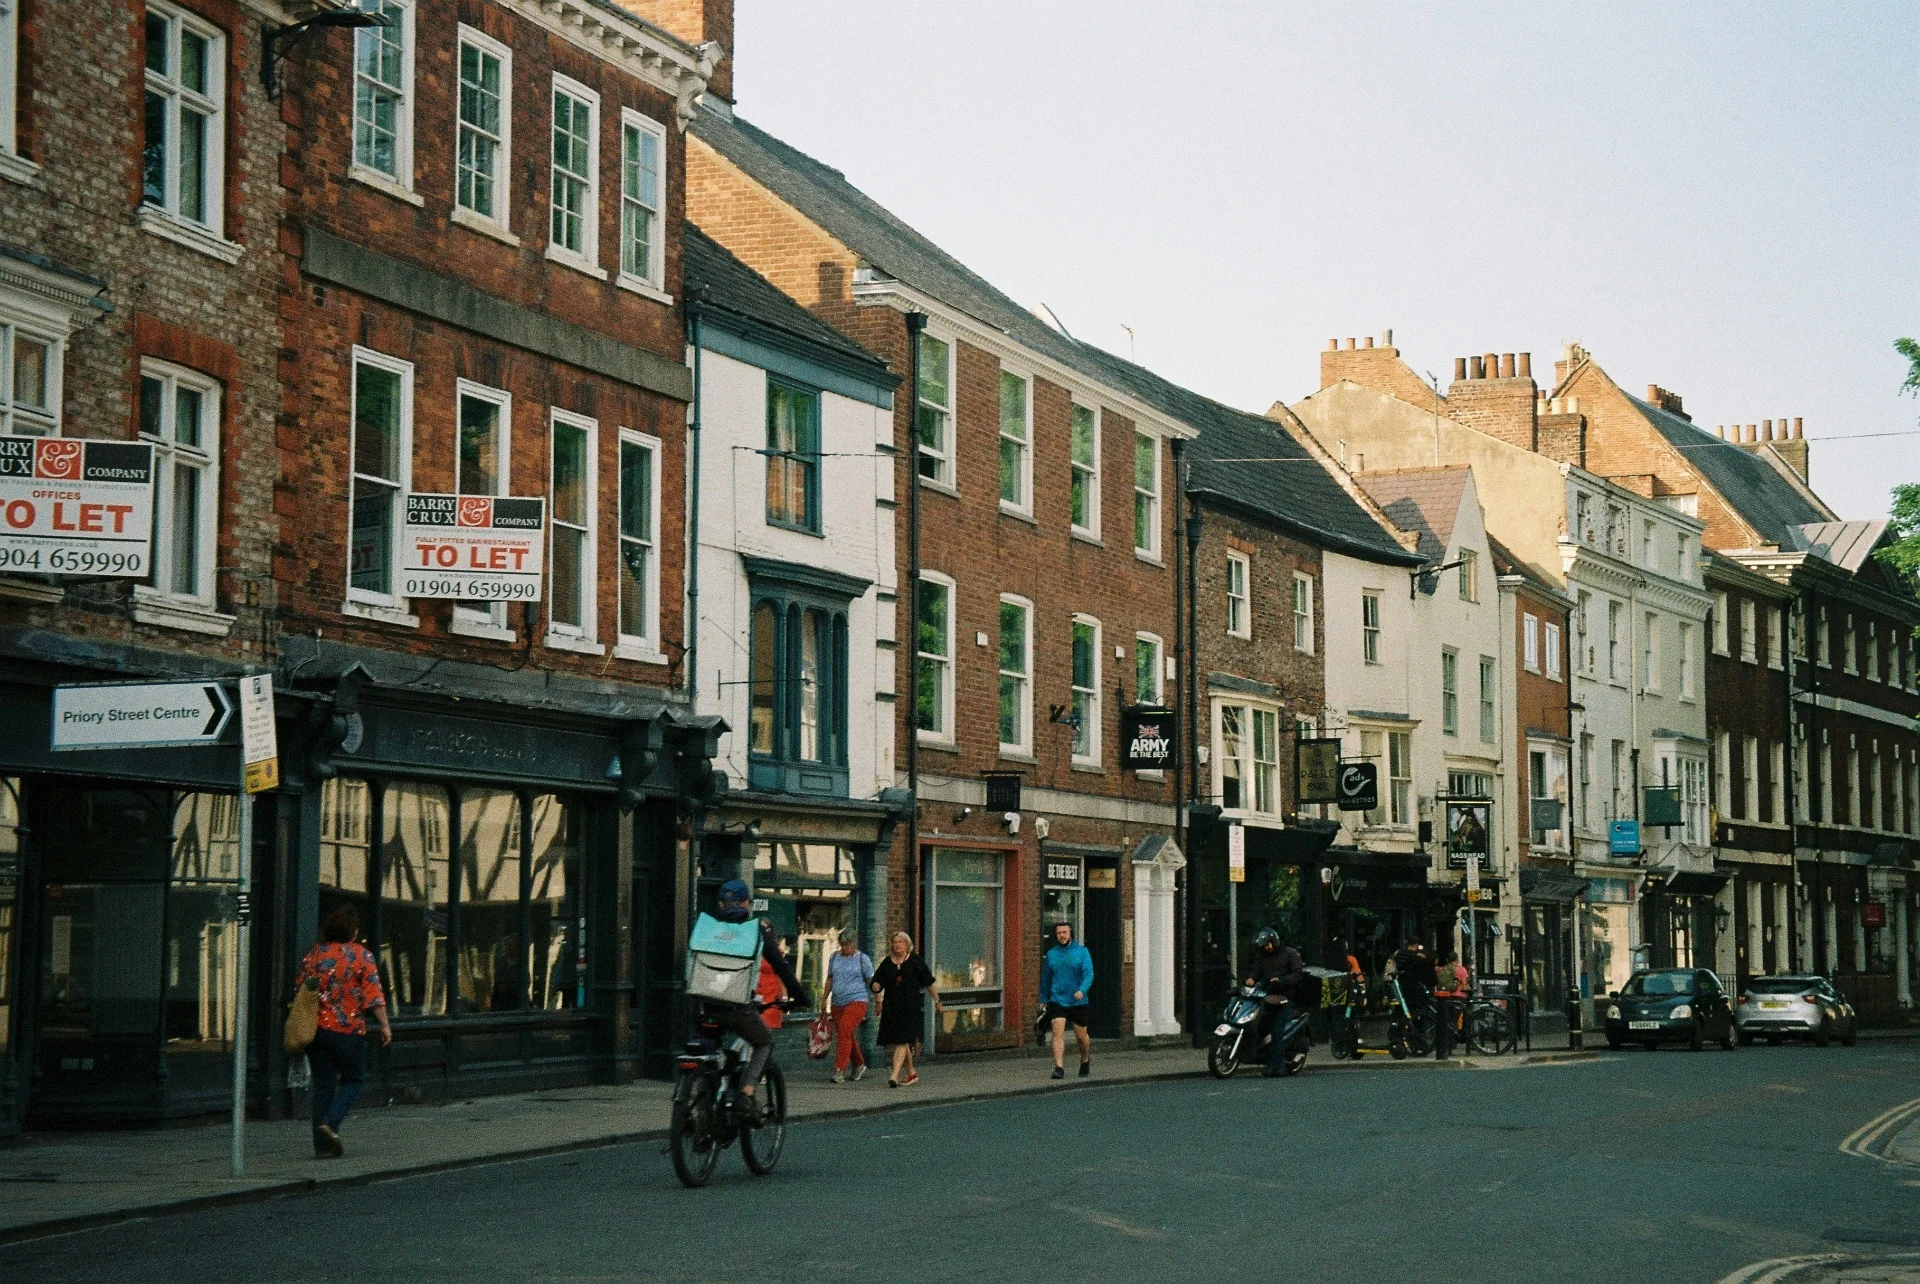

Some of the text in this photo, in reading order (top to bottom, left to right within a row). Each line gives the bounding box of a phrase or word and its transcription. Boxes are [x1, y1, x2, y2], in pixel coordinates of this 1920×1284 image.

[38, 441, 80, 478] &
[87, 466, 147, 479] COMPANY
[32, 490, 81, 500] OFFICES
[408, 498, 456, 511] BARRY
[0, 499, 133, 533] O LET
[407, 498, 540, 527] CRUX & COMPANY
[50, 548, 141, 573] 659990
[416, 544, 530, 570] TO LET
[406, 579, 536, 599] 01904 659990
[63, 706, 200, 725] Priory Street Centre
[1130, 738, 1169, 752] ARMY
[1048, 864, 1056, 878] BE
[1065, 865, 1078, 880] BEST
